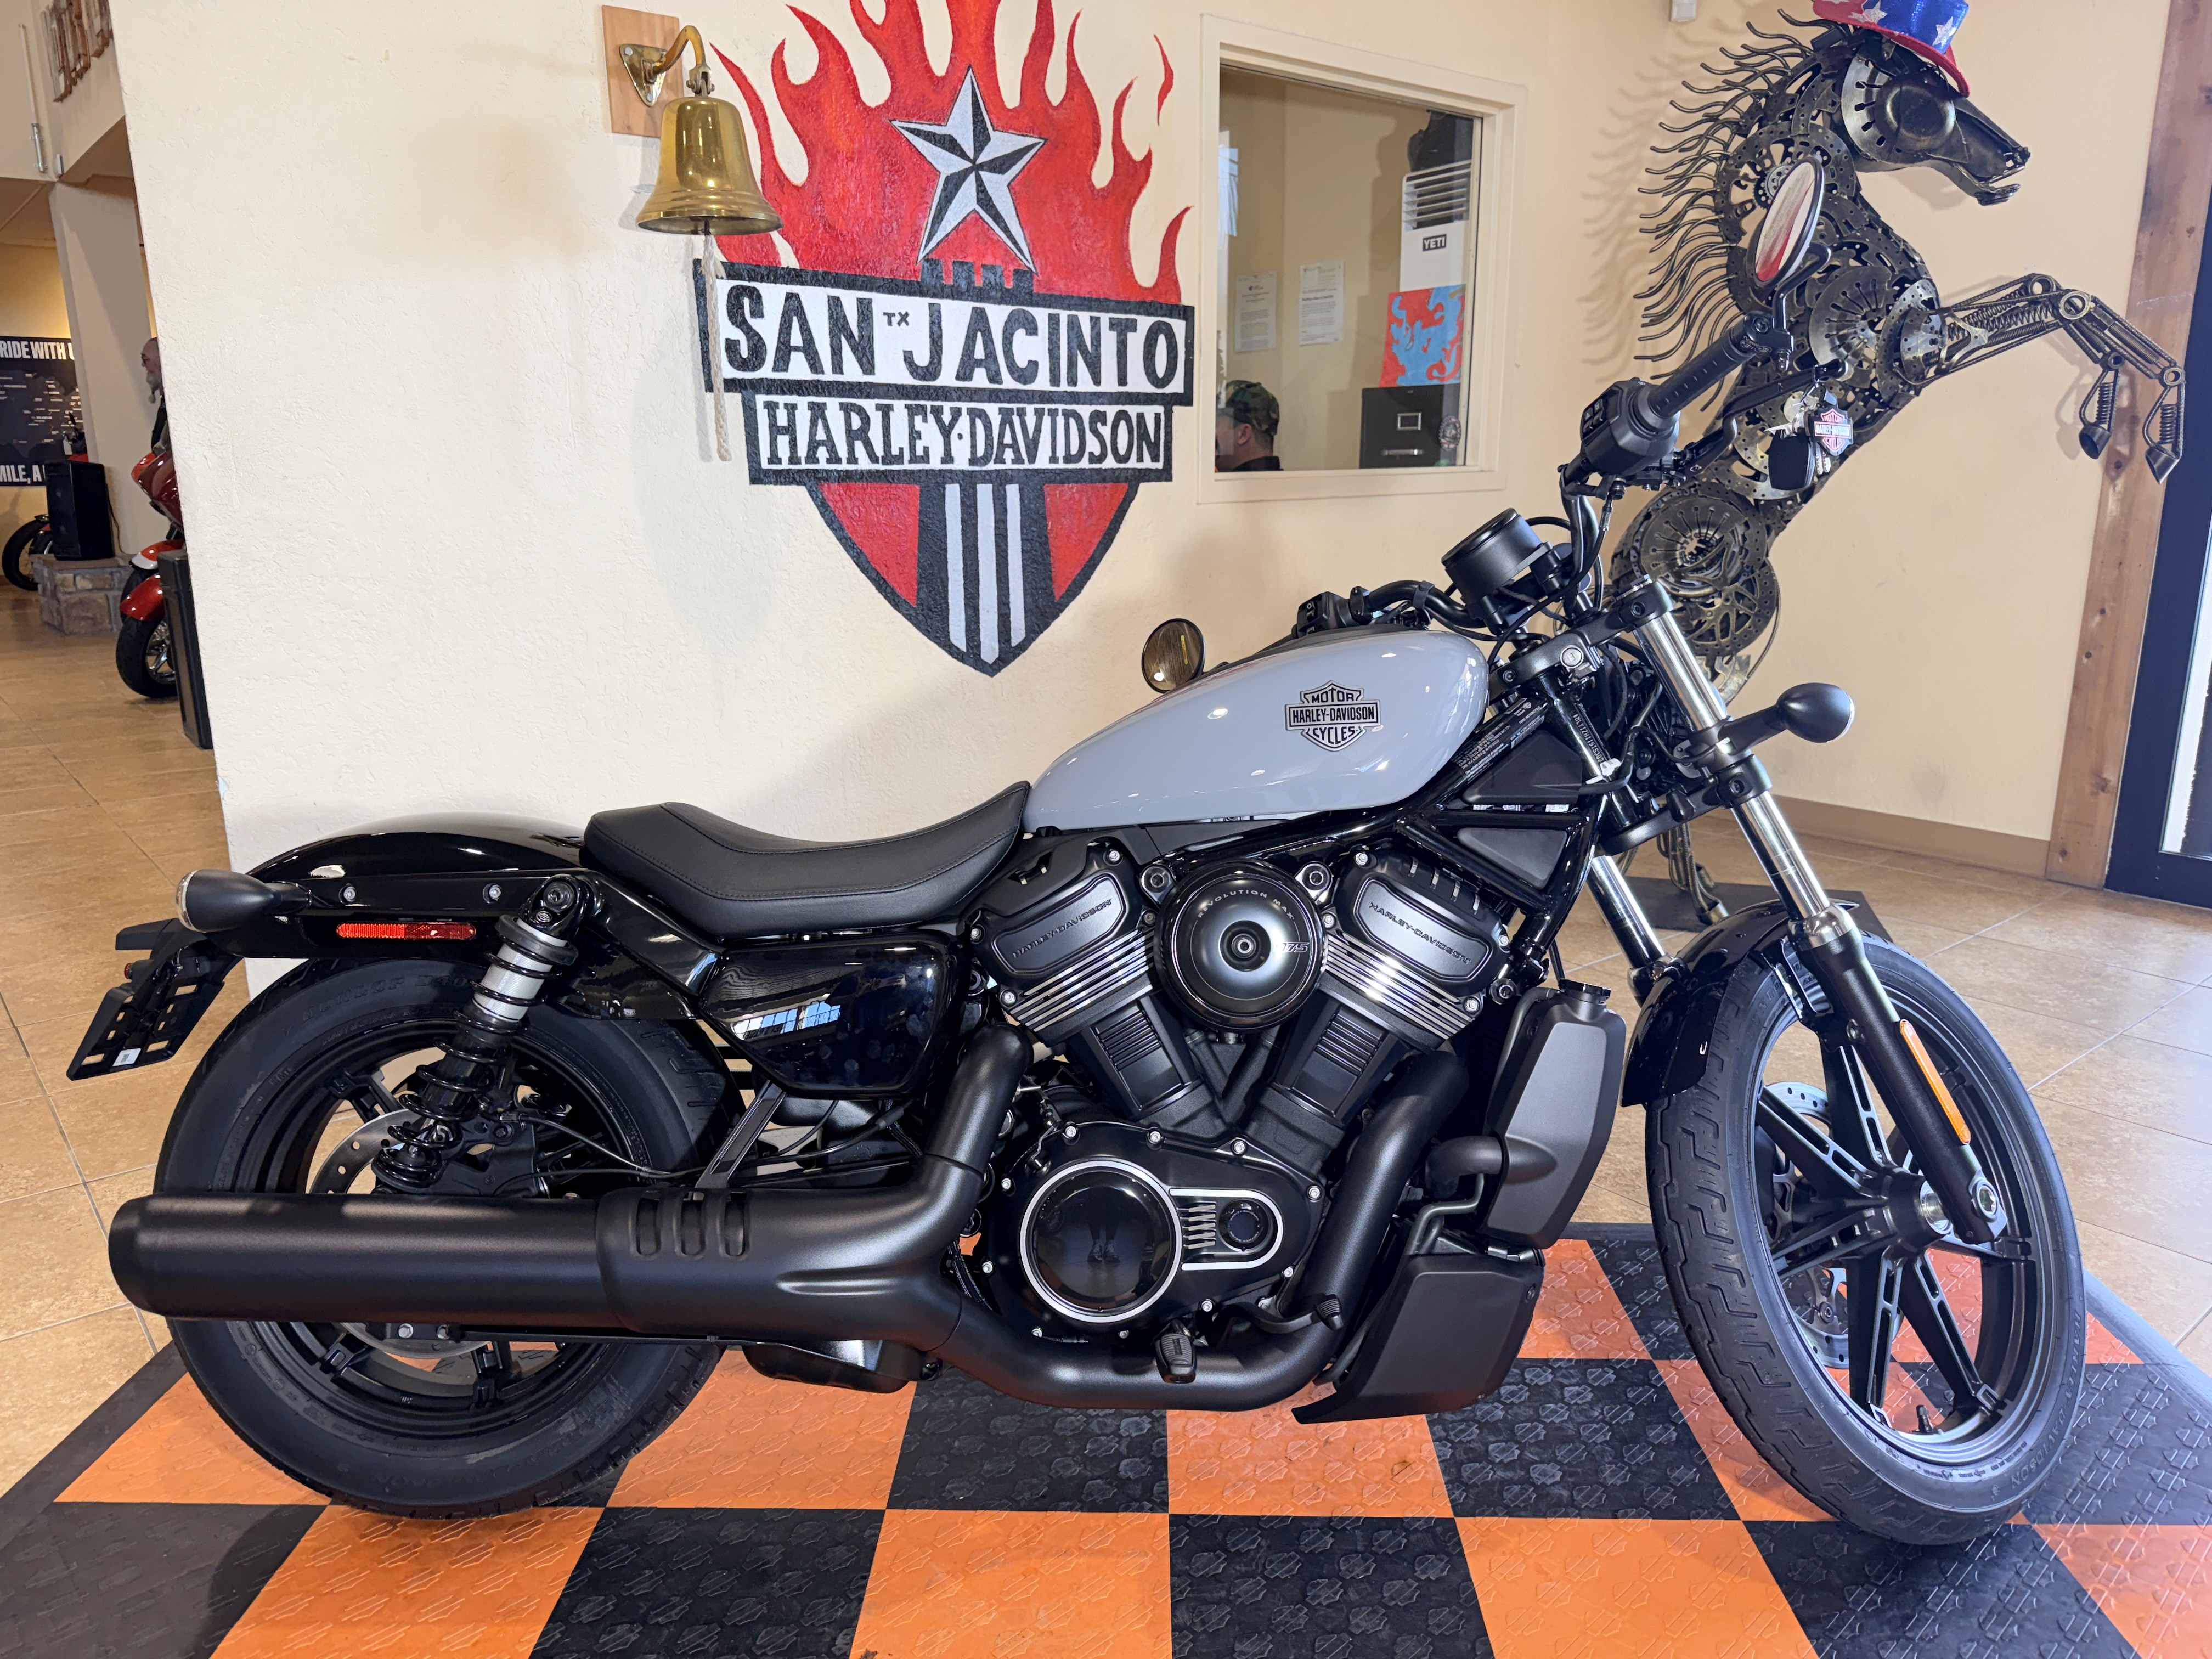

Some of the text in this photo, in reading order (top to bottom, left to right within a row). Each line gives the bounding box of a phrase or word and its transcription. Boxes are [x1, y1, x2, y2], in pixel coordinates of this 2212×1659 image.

[1424, 236, 1445, 249] YETI
[724, 284, 876, 376] SAN
[883, 311, 910, 328] TX
[903, 302, 1180, 390] JACINTO
[0, 340, 30, 358] RIDE
[30, 341, 66, 359] WITH
[1311, 687, 1355, 703] MOTOR
[1293, 706, 1374, 724] HARLEY-DAVIDSON
[1312, 726, 1356, 745] CYCLES
[1198, 889, 1293, 919] REVOLUTION MAX
[1012, 899, 1111, 958] HARLEY-DAVIDSON
[1369, 902, 1470, 964] HARLEY-DAVIDSON
